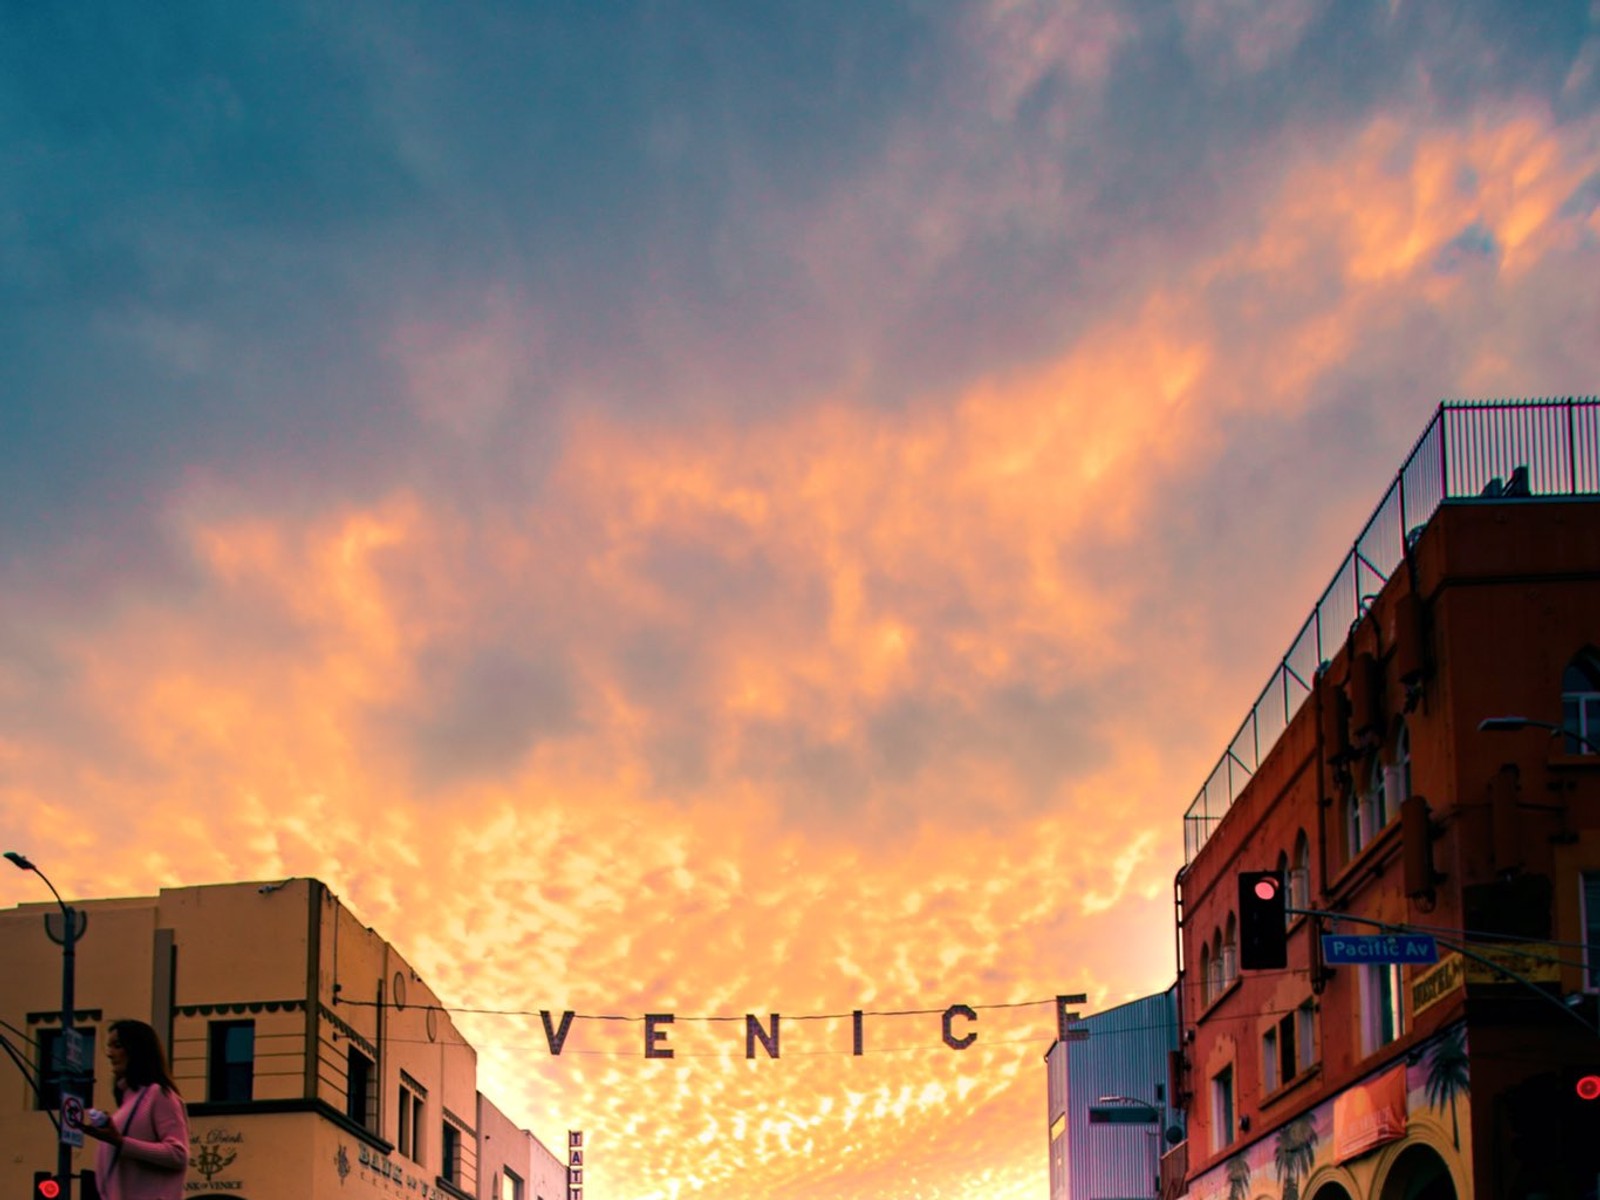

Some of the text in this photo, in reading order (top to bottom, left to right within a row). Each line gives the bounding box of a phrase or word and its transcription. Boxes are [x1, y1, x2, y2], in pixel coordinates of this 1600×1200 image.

[1333, 940, 1428, 956] Pacific Av
[540, 993, 1089, 1059] VENICE
[359, 1141, 402, 1186] BANK
[209, 1181, 242, 1190] VENICE
